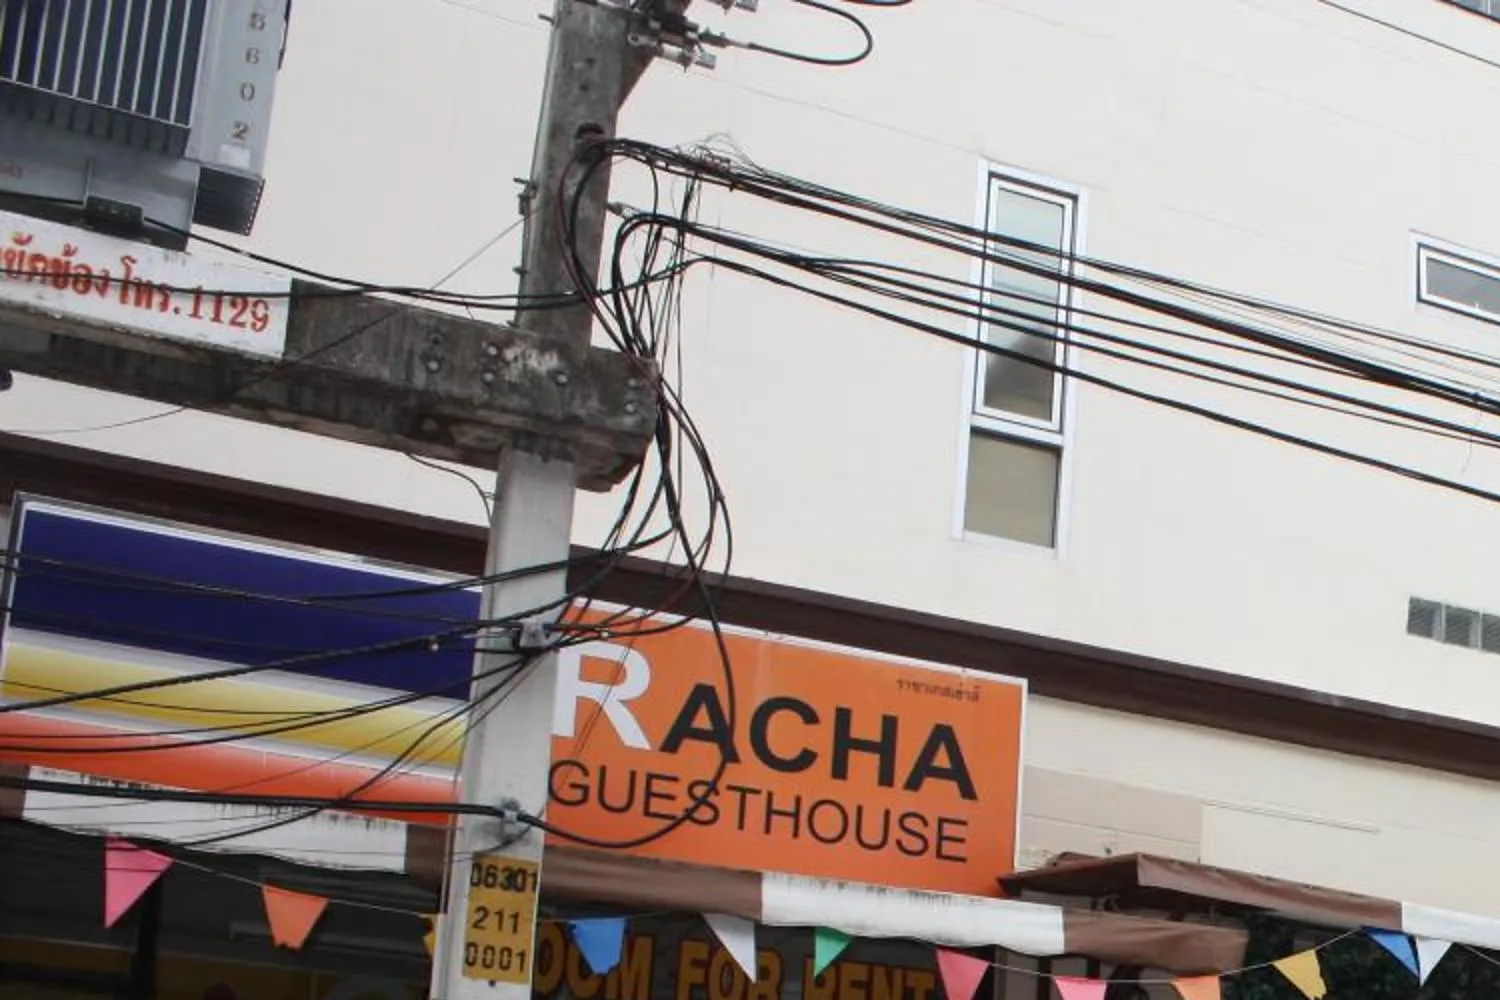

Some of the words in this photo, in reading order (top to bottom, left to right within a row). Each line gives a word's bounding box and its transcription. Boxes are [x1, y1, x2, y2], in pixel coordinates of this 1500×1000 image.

[550, 641, 979, 801] RACHA
[548, 759, 969, 864] GUESTHOUSE
[470, 862, 538, 893] 06301
[472, 905, 519, 935] 211
[466, 941, 526, 973] 0001
